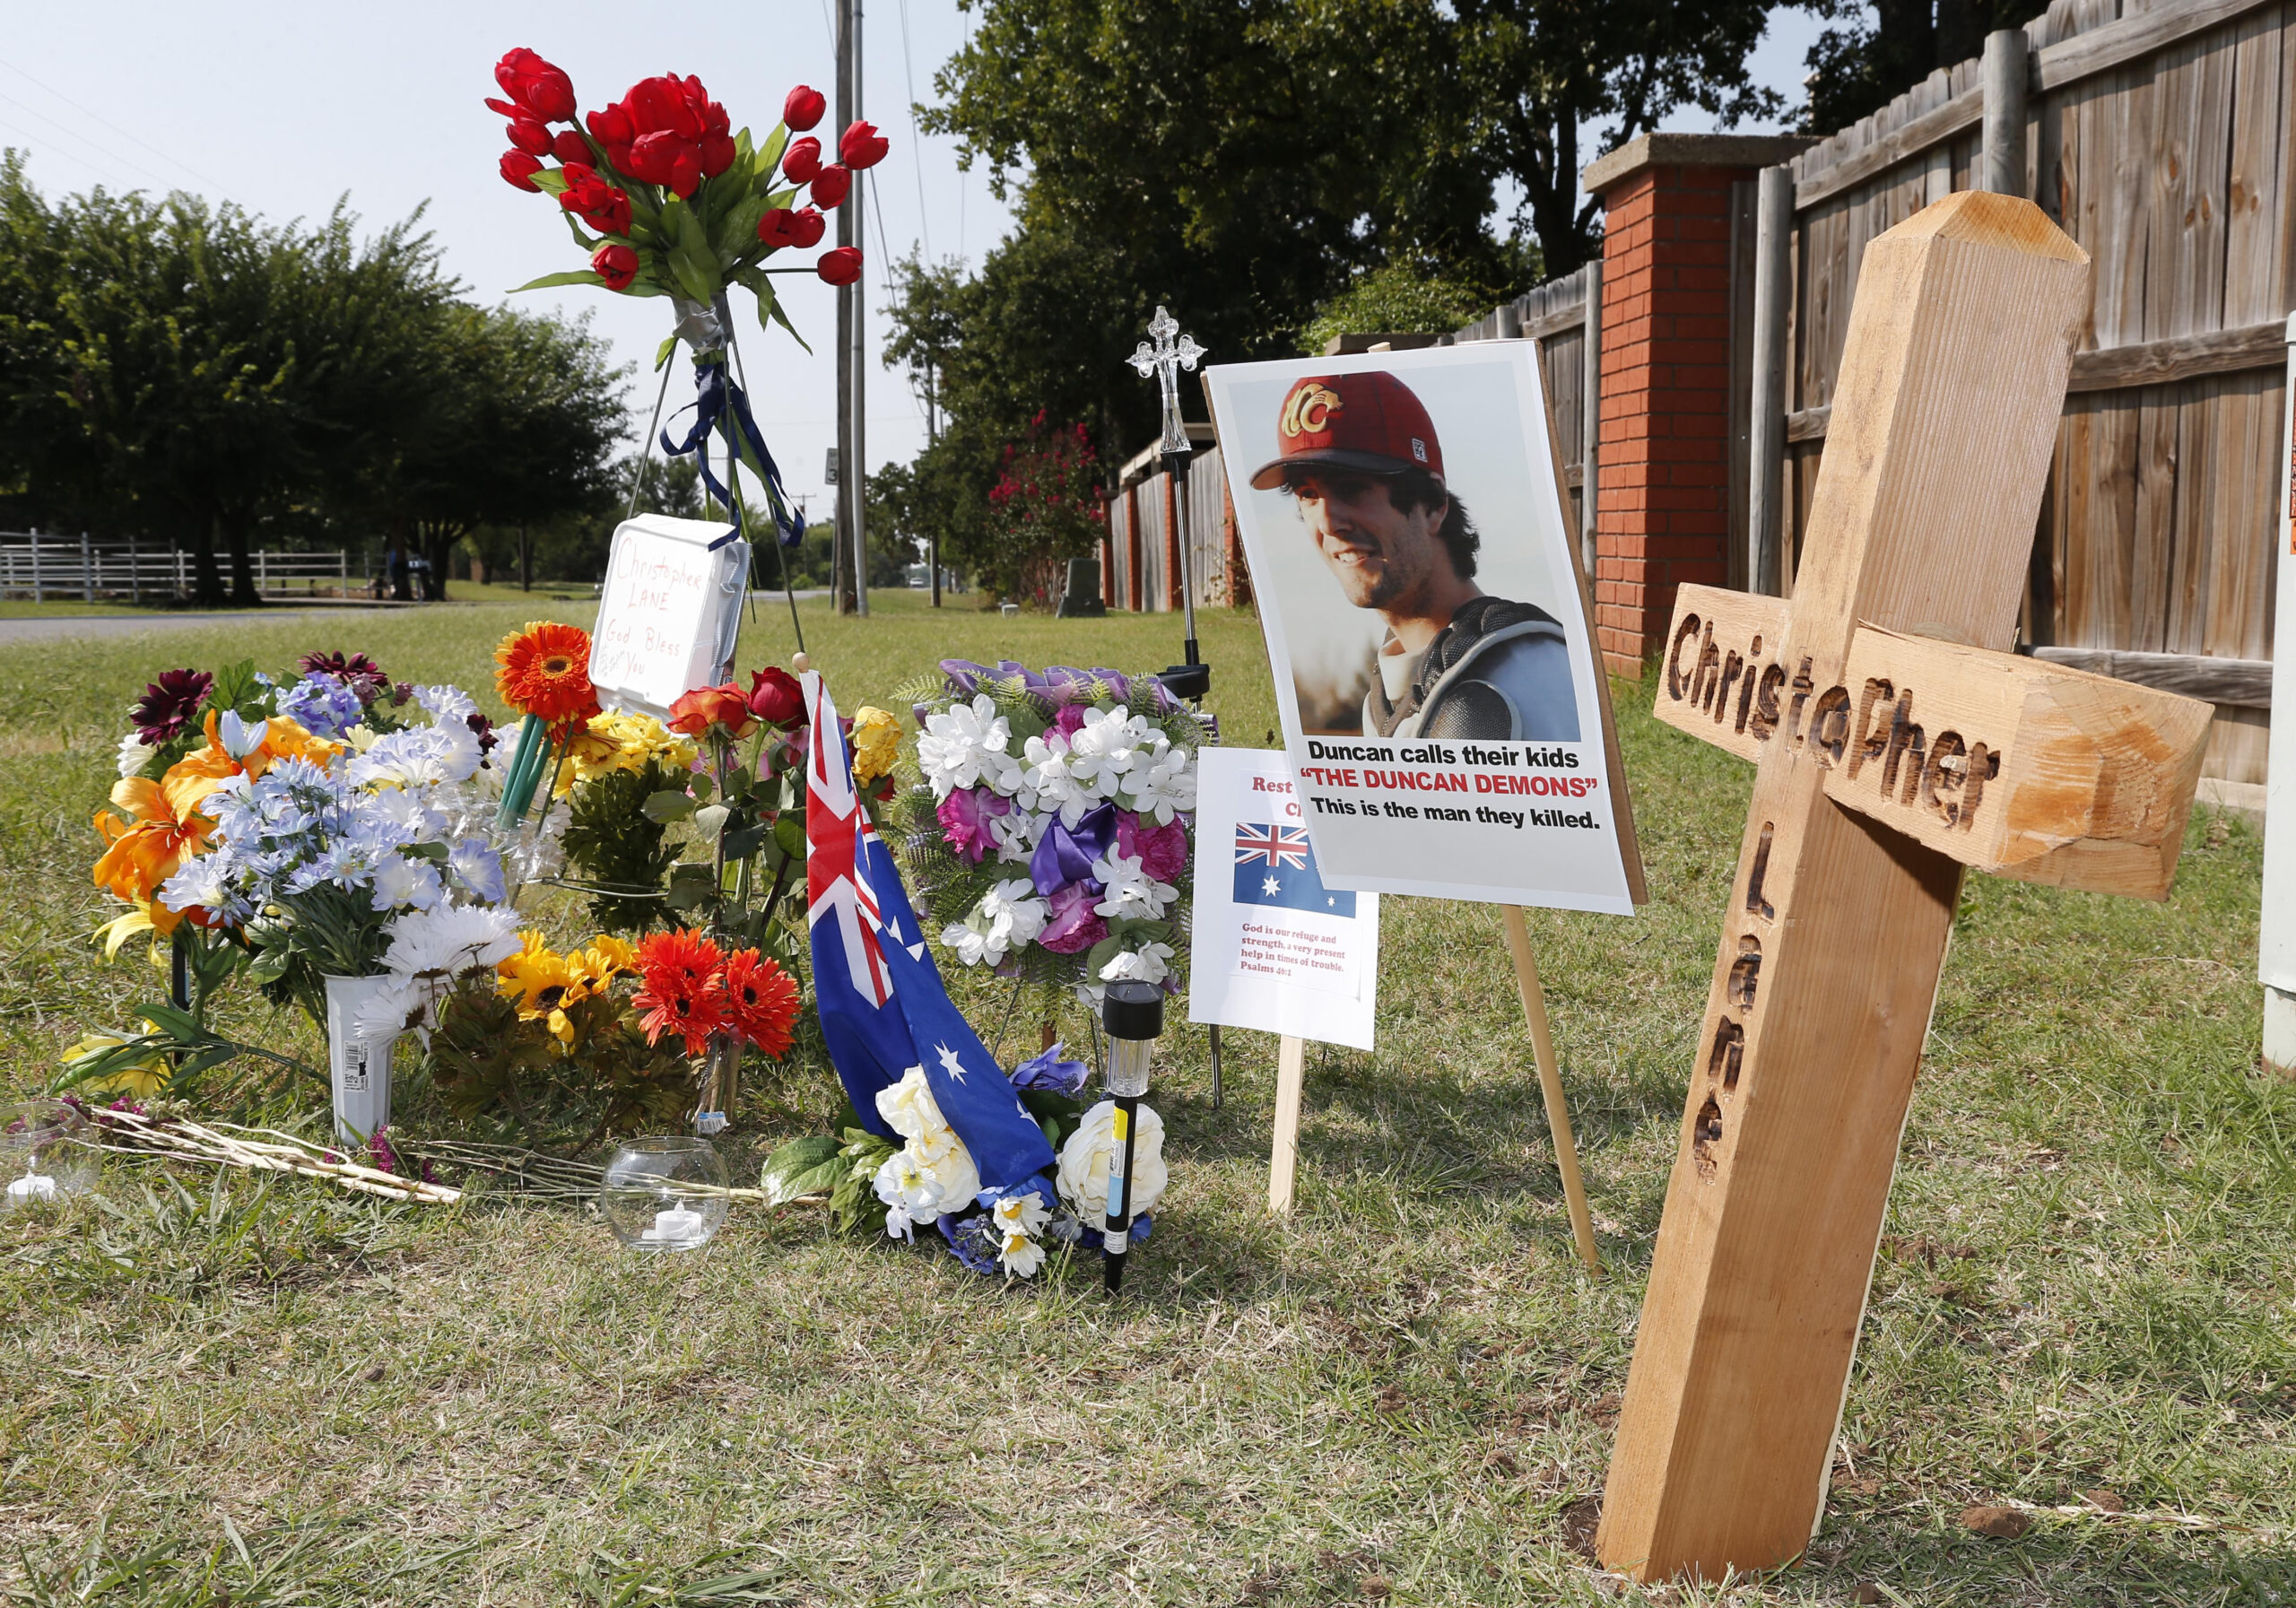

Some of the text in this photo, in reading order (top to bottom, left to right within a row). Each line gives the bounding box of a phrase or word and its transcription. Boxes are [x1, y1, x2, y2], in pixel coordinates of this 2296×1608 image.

[627, 583, 669, 610] LANE
[605, 618, 681, 656] God Bless
[623, 650, 645, 682] You
[1308, 740, 1579, 769] Duncan calls their kids
[1252, 777, 1293, 794] Rest
[1300, 767, 1597, 798] “THE DUNCAN DEMONS”
[1310, 796, 1601, 829] This is the man they killed.
[1242, 923, 1336, 944] God is our refuge and
[1240, 948, 1344, 972] help in times of trouble.
[1241, 936, 1286, 951] strength,
[1293, 944, 1312, 955] very
[1314, 947, 1345, 959] present
[1240, 960, 1274, 974] Psalms
